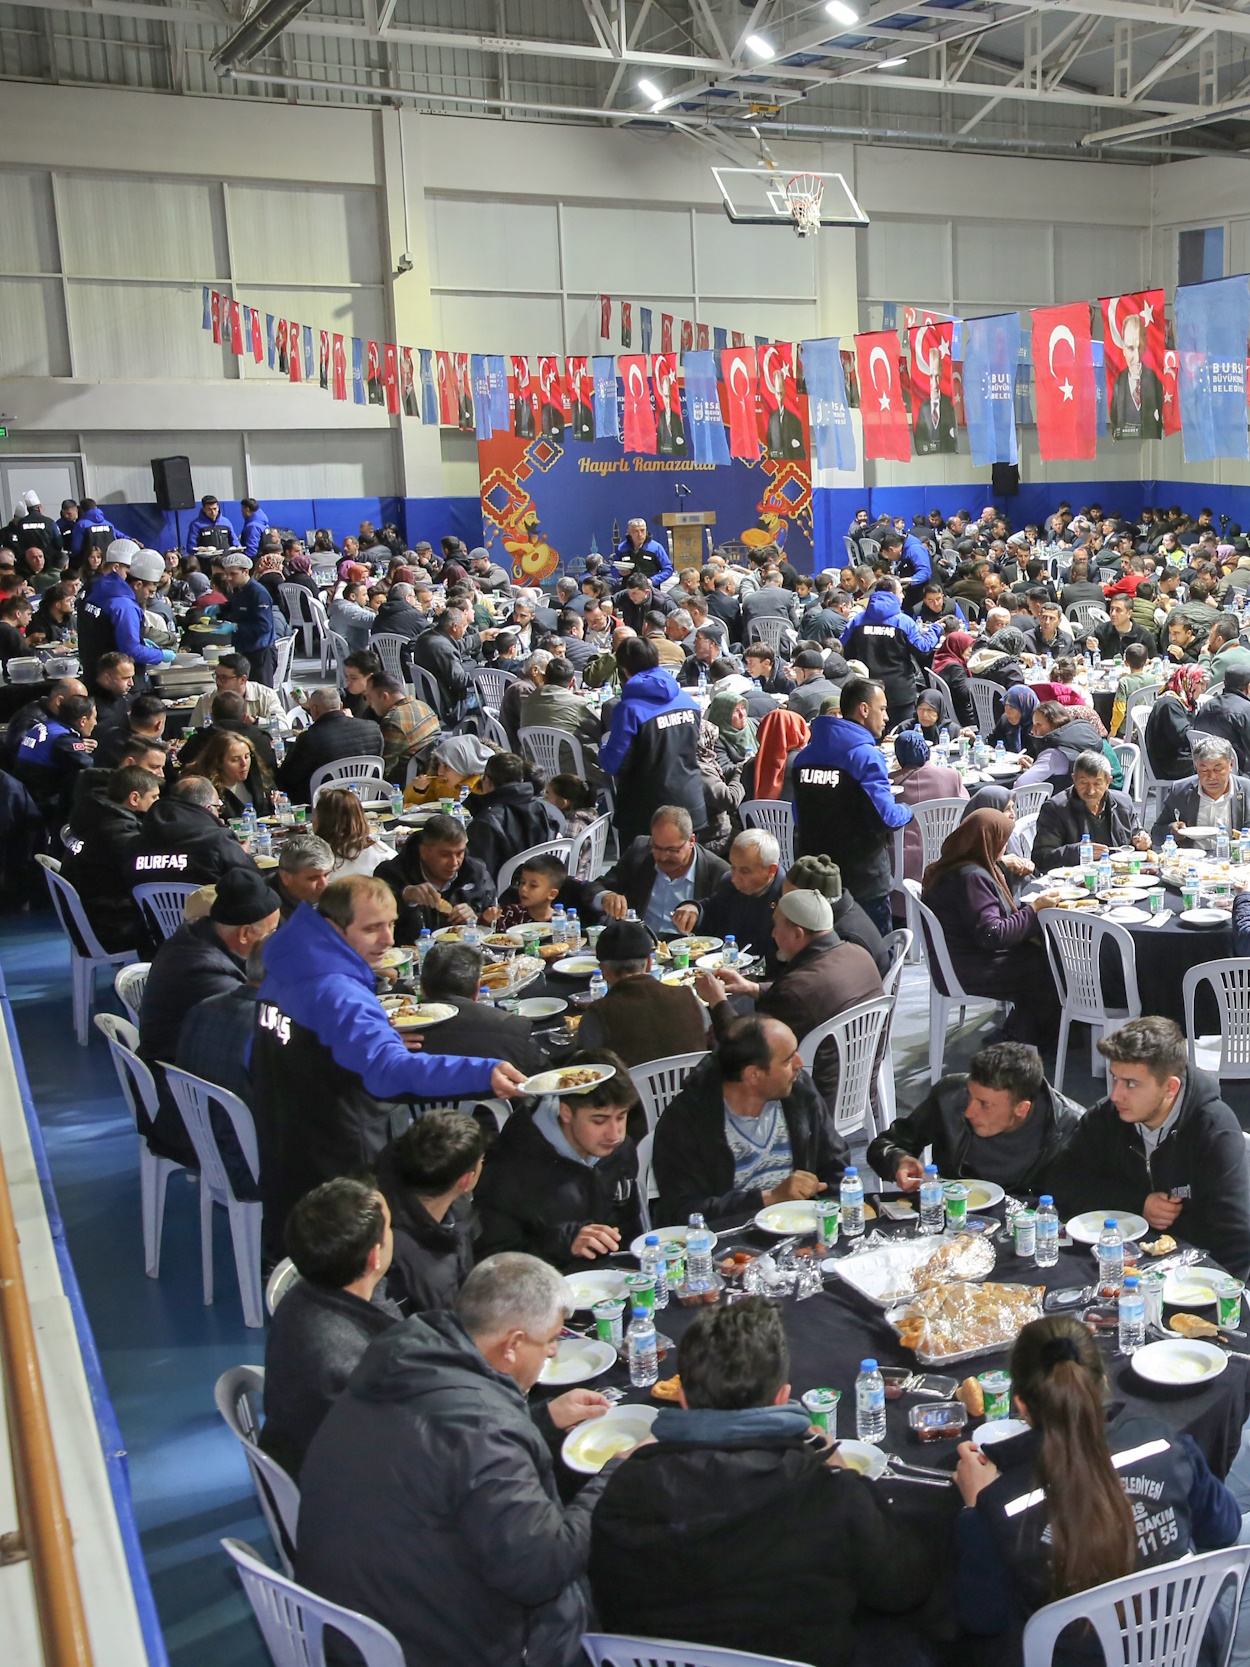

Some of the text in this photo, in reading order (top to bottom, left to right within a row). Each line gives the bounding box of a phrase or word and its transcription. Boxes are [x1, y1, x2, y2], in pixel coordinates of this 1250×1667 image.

[578, 457, 630, 477] Hayırlı
[656, 709, 695, 730] BURFAŞ
[135, 854, 188, 871] BURFAŞ
[1119, 1474, 1165, 1500] ELEDİYESİ
[1135, 1506, 1175, 1536] BAKIM
[1137, 1520, 1179, 1556] 11 55
